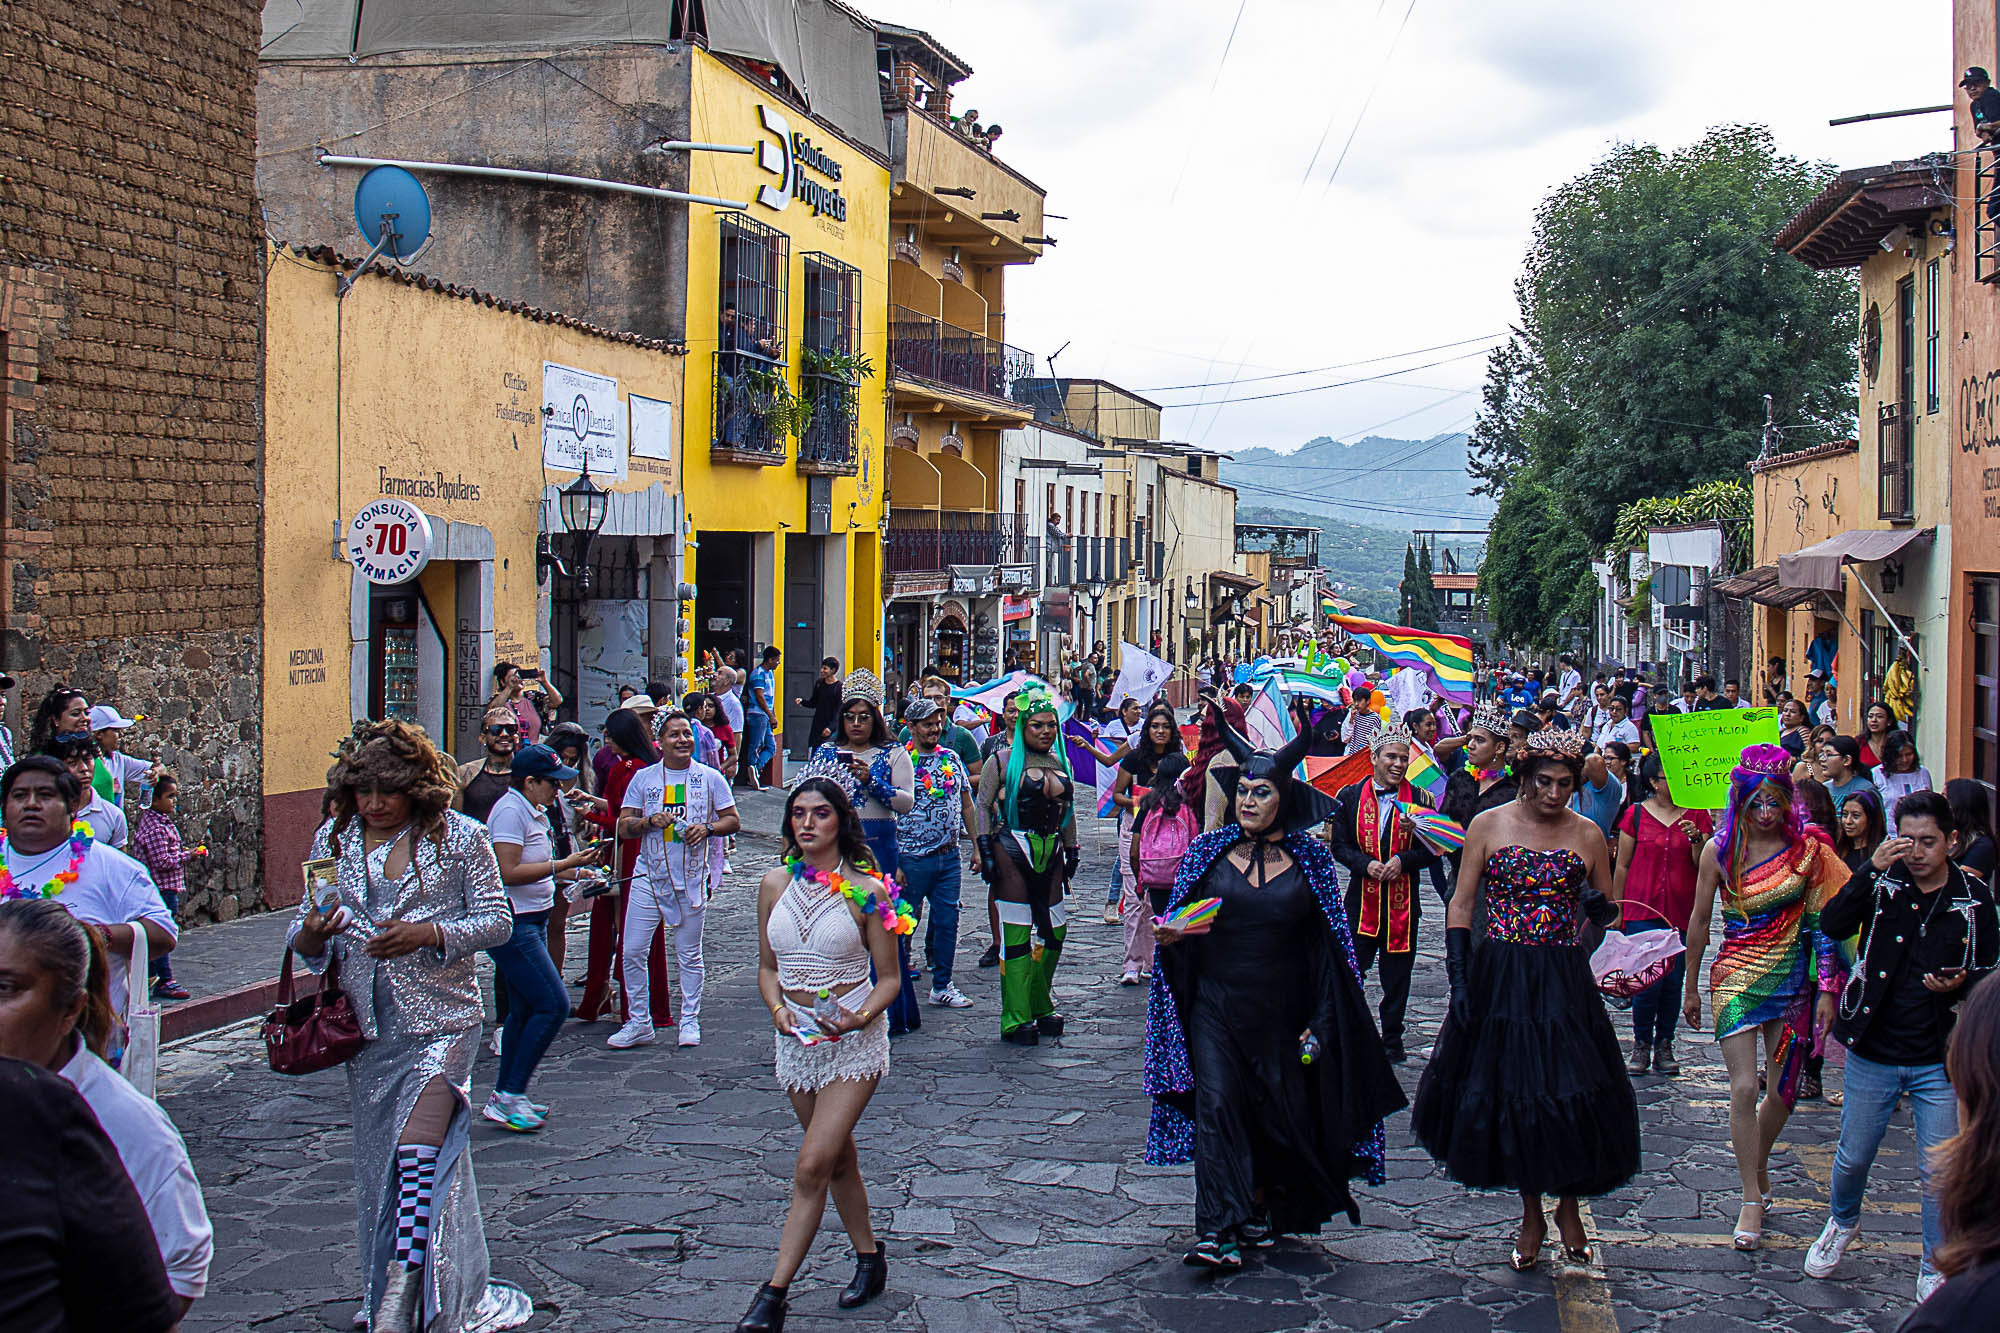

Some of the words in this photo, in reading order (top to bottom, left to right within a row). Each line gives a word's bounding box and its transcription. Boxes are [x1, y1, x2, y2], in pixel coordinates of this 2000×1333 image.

[793, 132, 842, 182] Soluciones
[793, 164, 846, 221] Proyecta
[590, 410, 615, 431] Dental
[379, 466, 435, 498] Farmacias
[436, 471, 480, 504] Populares
[355, 503, 418, 533] CONSULTA
[351, 546, 421, 580] FARMACIA
[289, 648, 324, 667] MEDICINA
[469, 634, 479, 720] PATENTE
[1511, 694, 1525, 703] Lee
[1666, 731, 1673, 742] Y
[1667, 744, 1700, 756] PARA
[1682, 760, 1699, 770] LA
